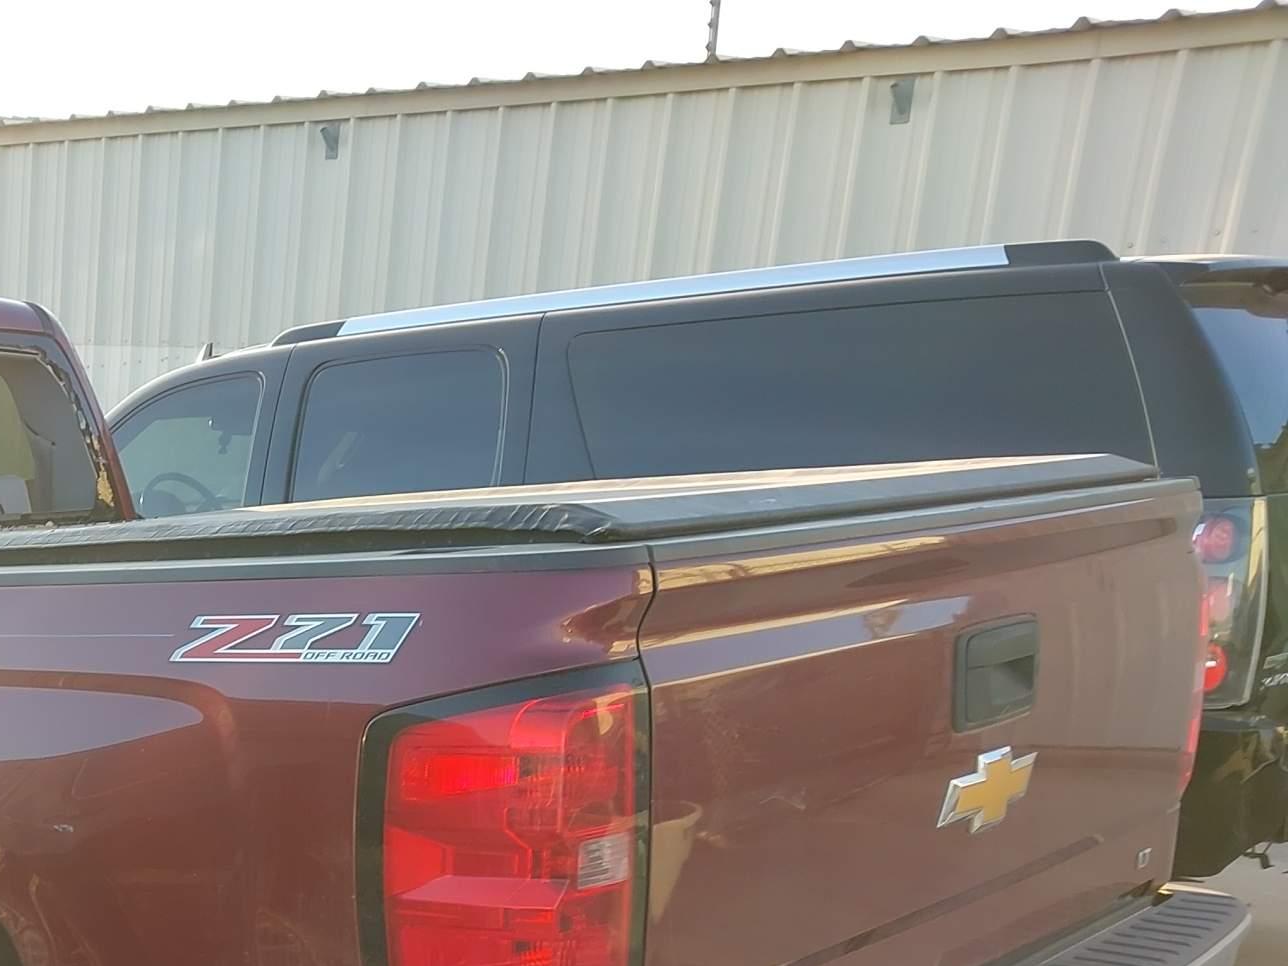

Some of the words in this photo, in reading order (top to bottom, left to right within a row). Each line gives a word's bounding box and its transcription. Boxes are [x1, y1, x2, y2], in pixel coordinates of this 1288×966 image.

[168, 613, 421, 662] Z71
[303, 651, 338, 661] OFF
[341, 651, 391, 661] ROAD
